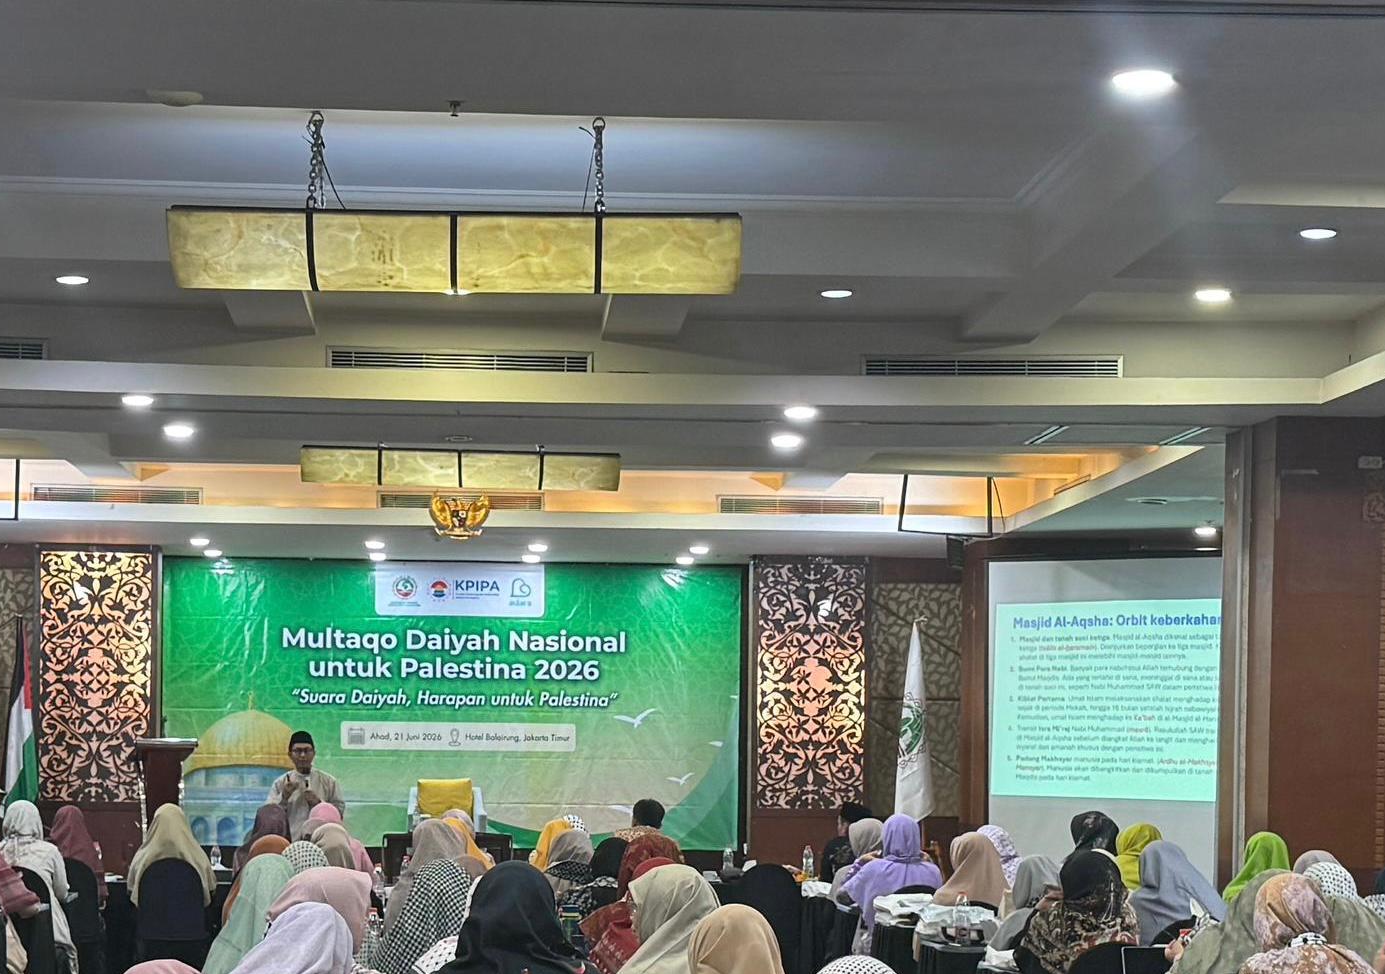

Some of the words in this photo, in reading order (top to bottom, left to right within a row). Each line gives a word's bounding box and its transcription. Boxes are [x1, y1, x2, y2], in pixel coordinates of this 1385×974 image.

[455, 580, 500, 592] KPIPA
[1013, 616, 1052, 631] Masjid
[1054, 615, 1113, 629] Al-Aqsha:
[1116, 614, 1147, 626] Orbit
[282, 627, 398, 654] Multaqo
[406, 628, 500, 656] Daiyah
[509, 629, 626, 653] Nasional
[309, 656, 393, 678] untuk
[400, 657, 526, 679] Palestina
[534, 659, 600, 680] 2026
[351, 689, 411, 709] Daiyah,
[417, 690, 485, 709] Harapan
[491, 689, 535, 706] untuk
[370, 732, 392, 742] Ahad,
[394, 732, 404, 740] 21
[406, 732, 420, 741] Juni
[422, 732, 442, 740] 2026
[465, 732, 484, 741] Hotel
[523, 733, 549, 742] Jakarta
[551, 733, 570, 742] Timur
